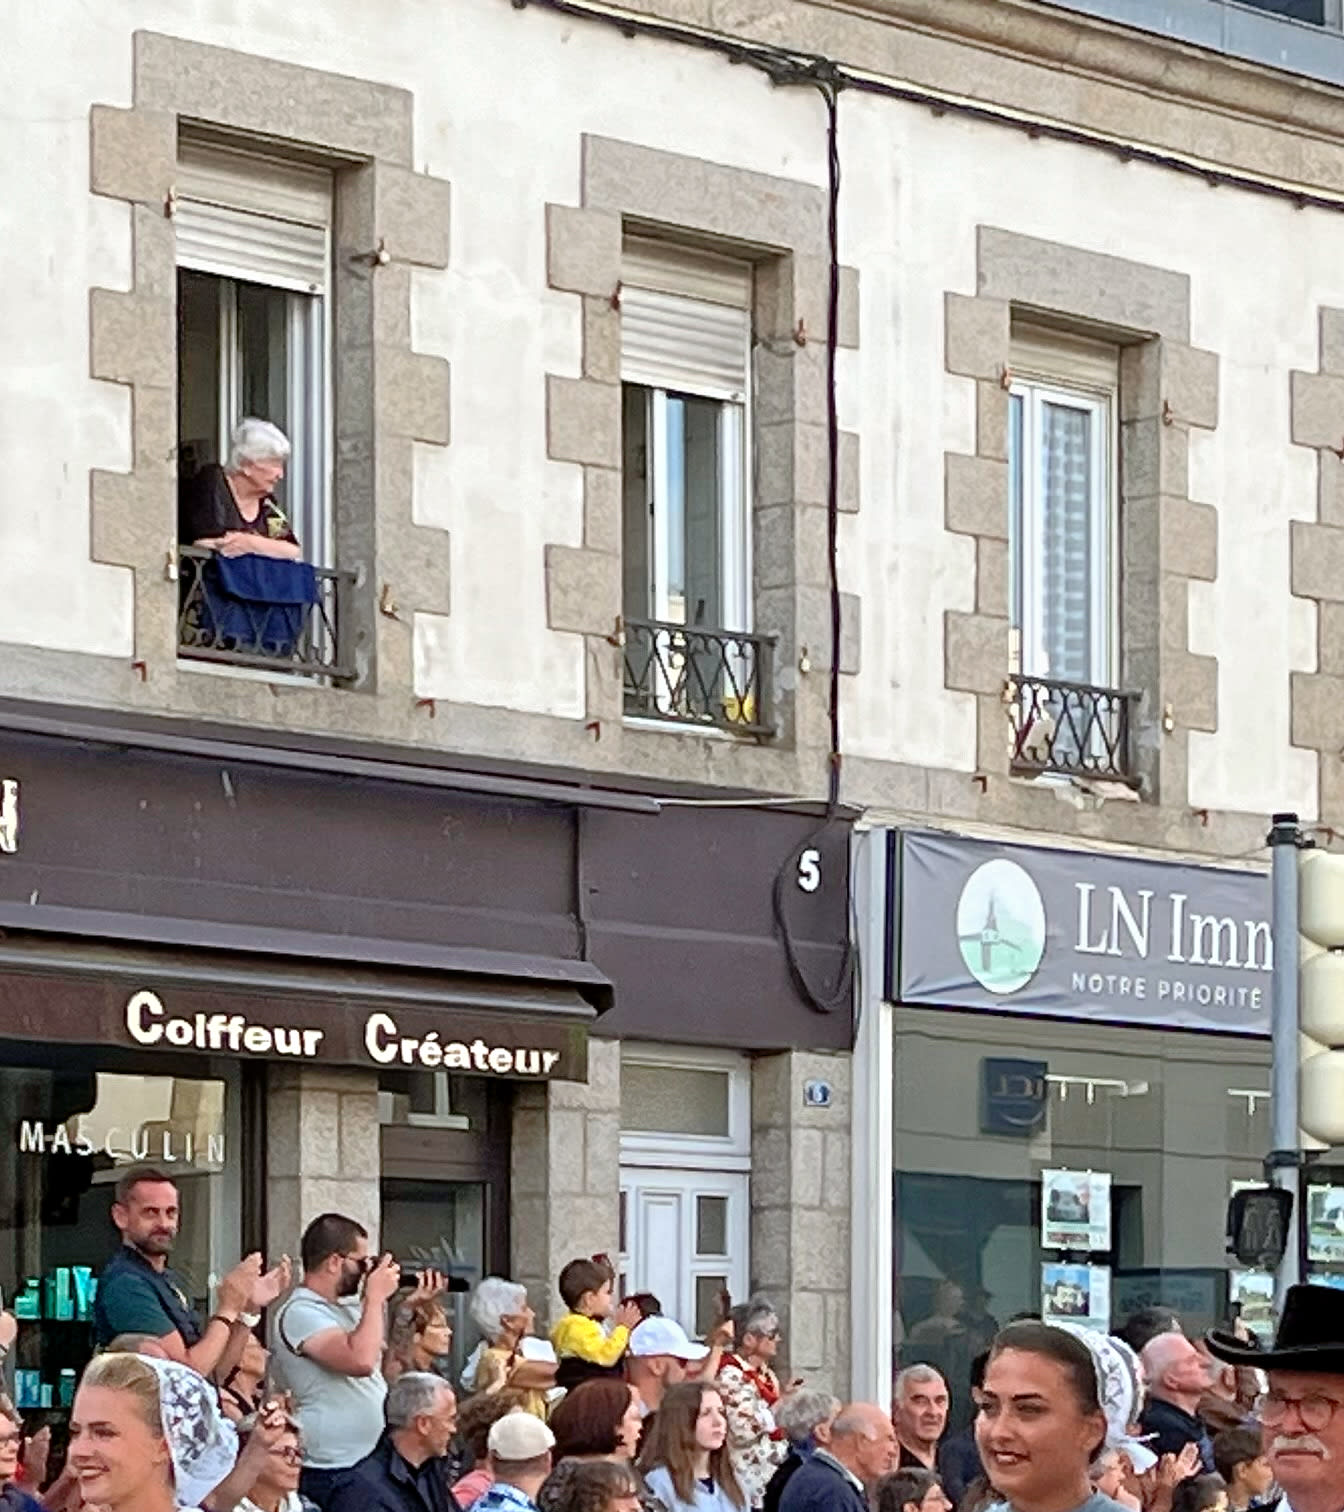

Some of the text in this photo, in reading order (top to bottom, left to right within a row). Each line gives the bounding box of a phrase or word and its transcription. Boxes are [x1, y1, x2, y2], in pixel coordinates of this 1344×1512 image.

[798, 850, 820, 892] 5
[1073, 882, 1155, 959] LN
[1071, 971, 1147, 1000] NOTRE
[126, 990, 560, 1075] Coiffeur Créateur
[19, 1119, 225, 1163] MASCULIN
